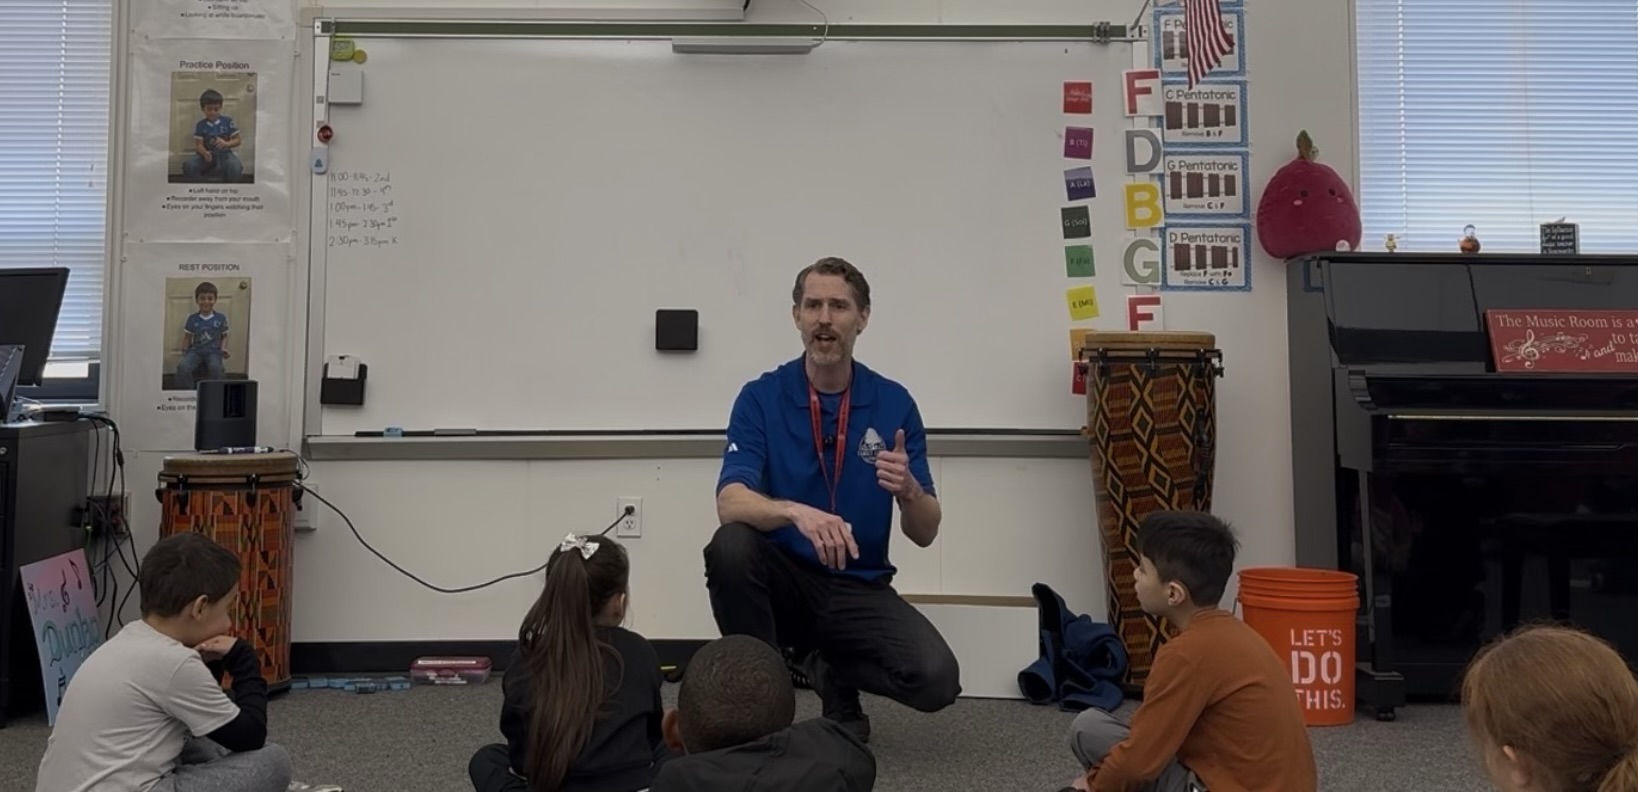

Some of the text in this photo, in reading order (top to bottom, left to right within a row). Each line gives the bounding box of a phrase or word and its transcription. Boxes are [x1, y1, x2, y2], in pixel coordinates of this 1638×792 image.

[1164, 20, 1171, 29] F
[179, 61, 250, 70] Practice Position
[1125, 71, 1159, 114] F
[1166, 89, 1236, 100] C Pentatonic
[1125, 130, 1162, 173] D
[1167, 160, 1238, 171] G Pentatonic
[1125, 183, 1163, 227] B
[1169, 232, 1241, 244] D Pentatonic
[178, 263, 240, 272] REST POSITION
[1123, 239, 1160, 284] G
[1208, 278, 1214, 286] C
[1222, 278, 1229, 286] G
[1128, 297, 1161, 331] F
[1495, 314, 1635, 328] The Music Room is a
[1612, 333, 1626, 345] to
[1593, 340, 1616, 358] and
[1290, 628, 1342, 647] LET'S
[1291, 651, 1342, 684] DO
